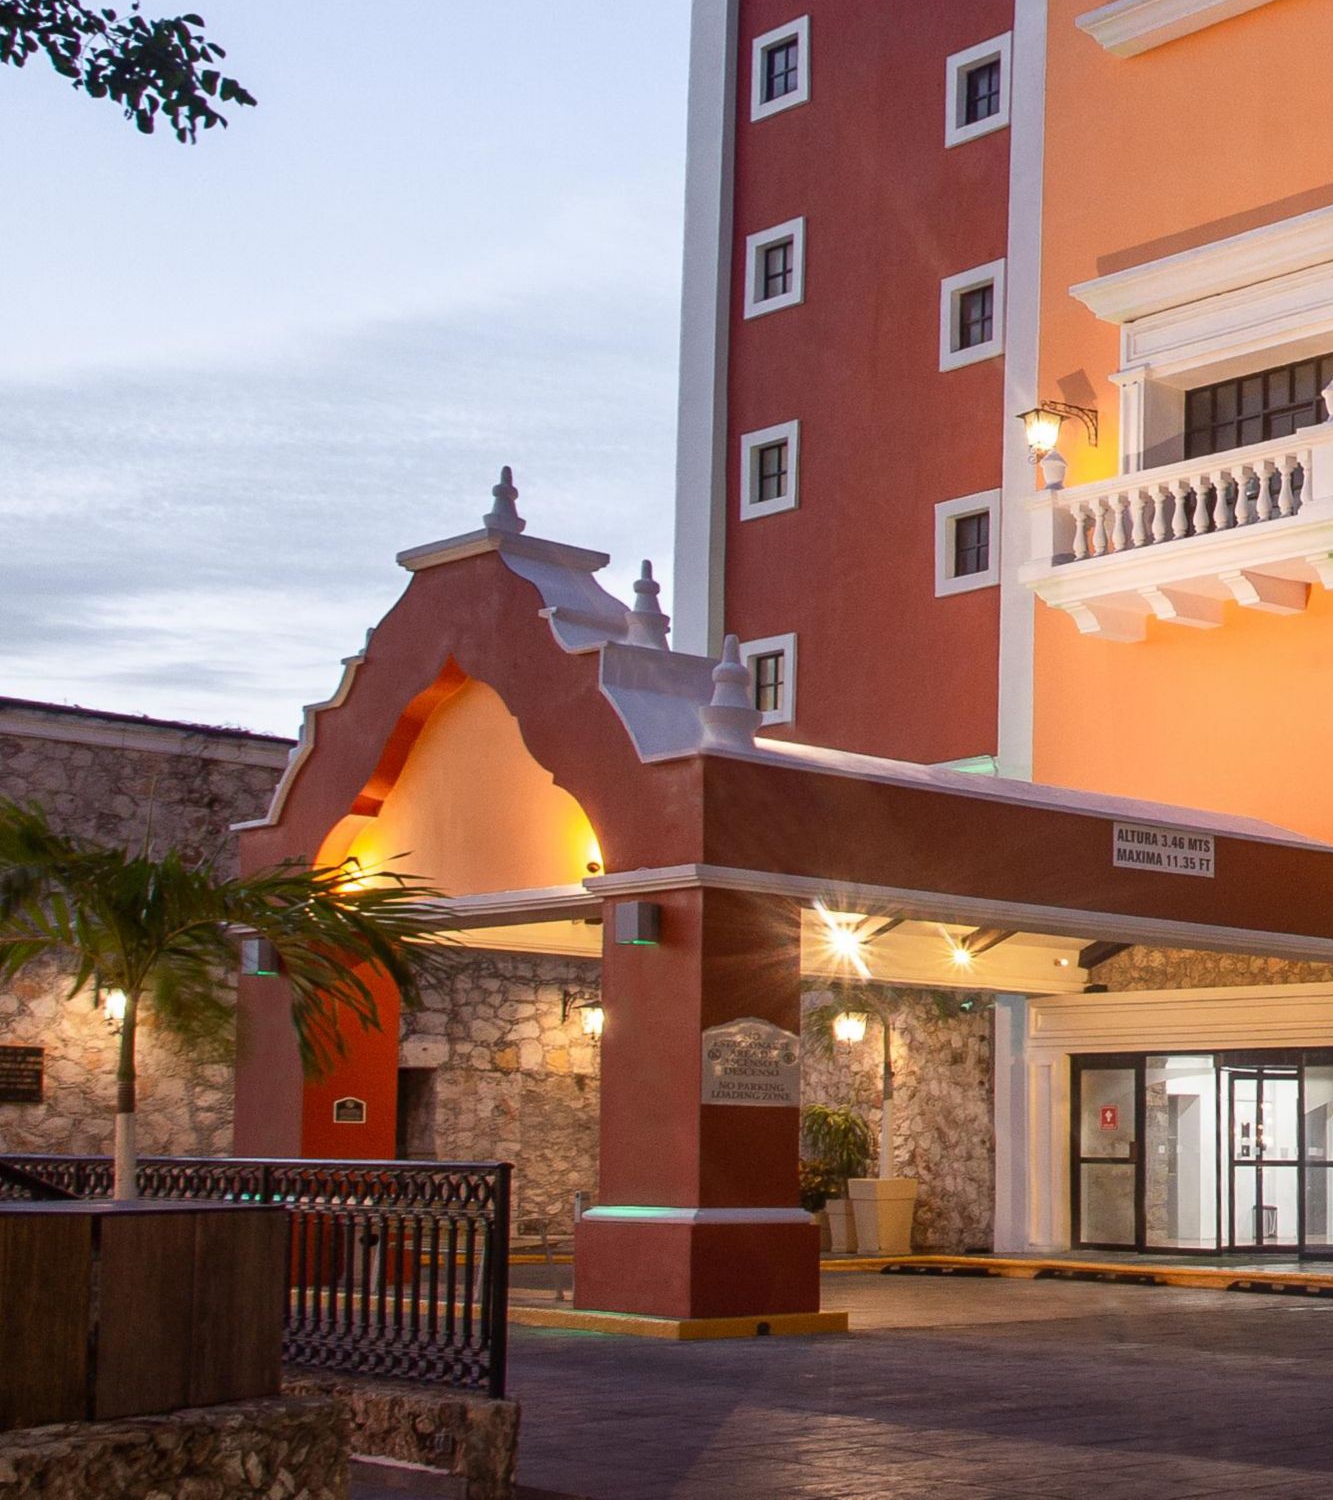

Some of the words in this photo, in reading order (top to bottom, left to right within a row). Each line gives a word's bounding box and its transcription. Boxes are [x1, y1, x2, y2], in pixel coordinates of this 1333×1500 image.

[1117, 829, 1158, 846] ALTURA
[1161, 835, 1184, 850] 3.46
[1188, 838, 1210, 852] MTS
[1117, 848, 1162, 866] MAXIMA
[1167, 855, 1196, 870] 11.35
[1200, 858, 1211, 871] FT
[720, 1081, 735, 1090] NO
[737, 1082, 785, 1092] PARKING
[711, 1090, 760, 1100] LOADING
[761, 1093, 791, 1101] ZONE
